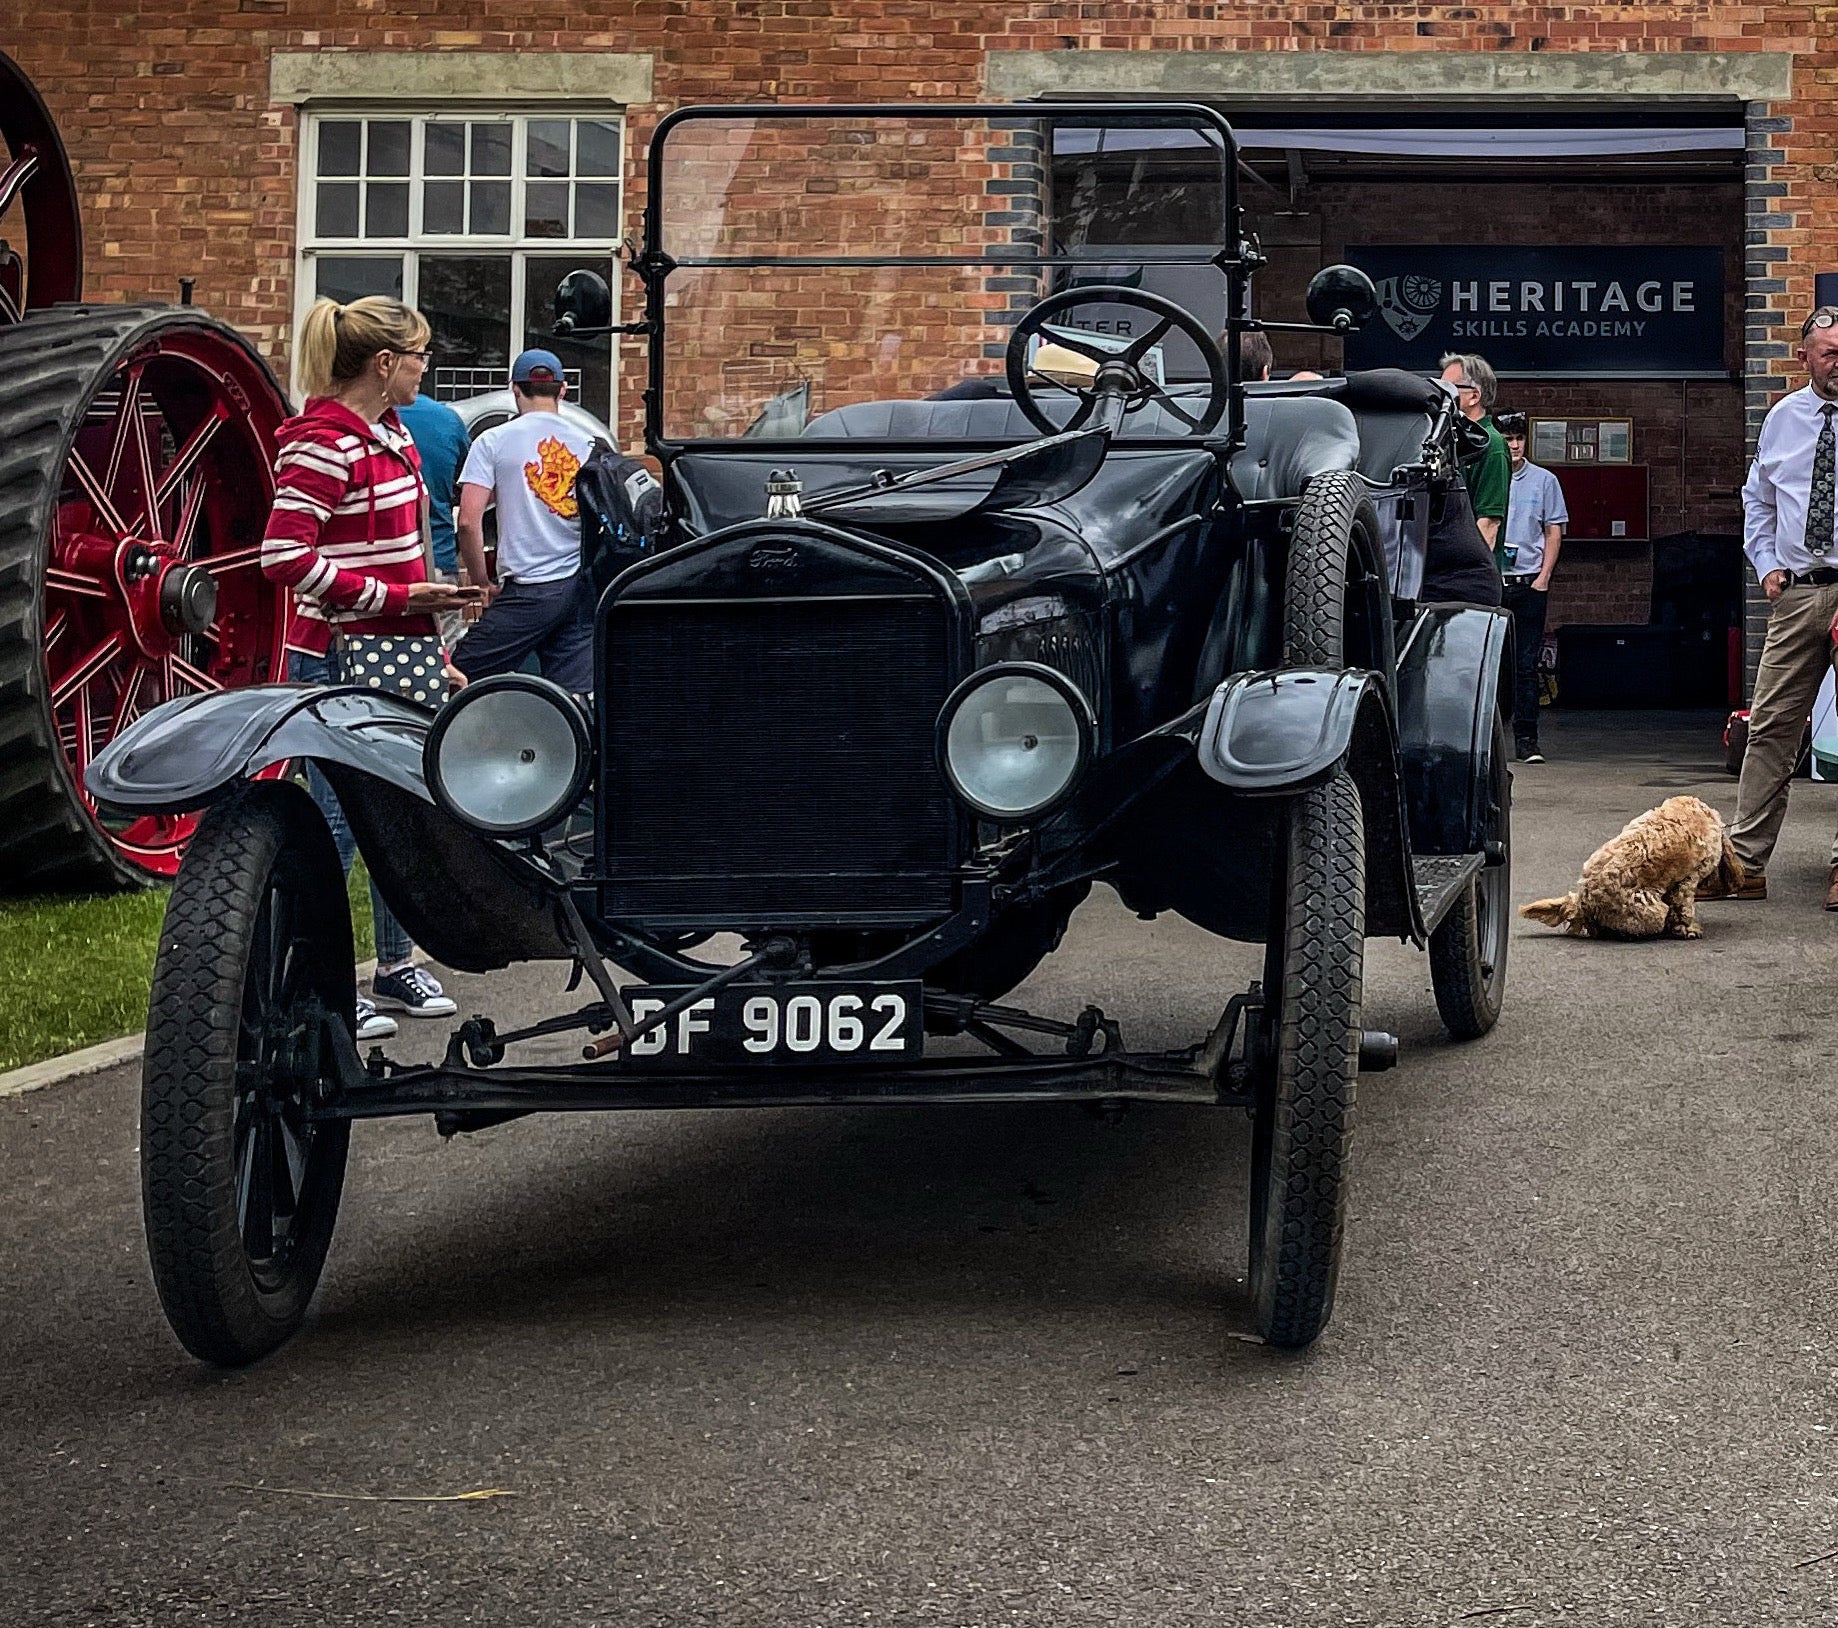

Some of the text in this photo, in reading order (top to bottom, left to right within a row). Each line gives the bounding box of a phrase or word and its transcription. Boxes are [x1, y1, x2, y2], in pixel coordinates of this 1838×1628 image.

[1452, 280, 1696, 313] HERITAGE
[1076, 319, 1132, 336] TER
[1452, 319, 1647, 338] SKILLS ACADEMY
[742, 994, 906, 1053] 9062
